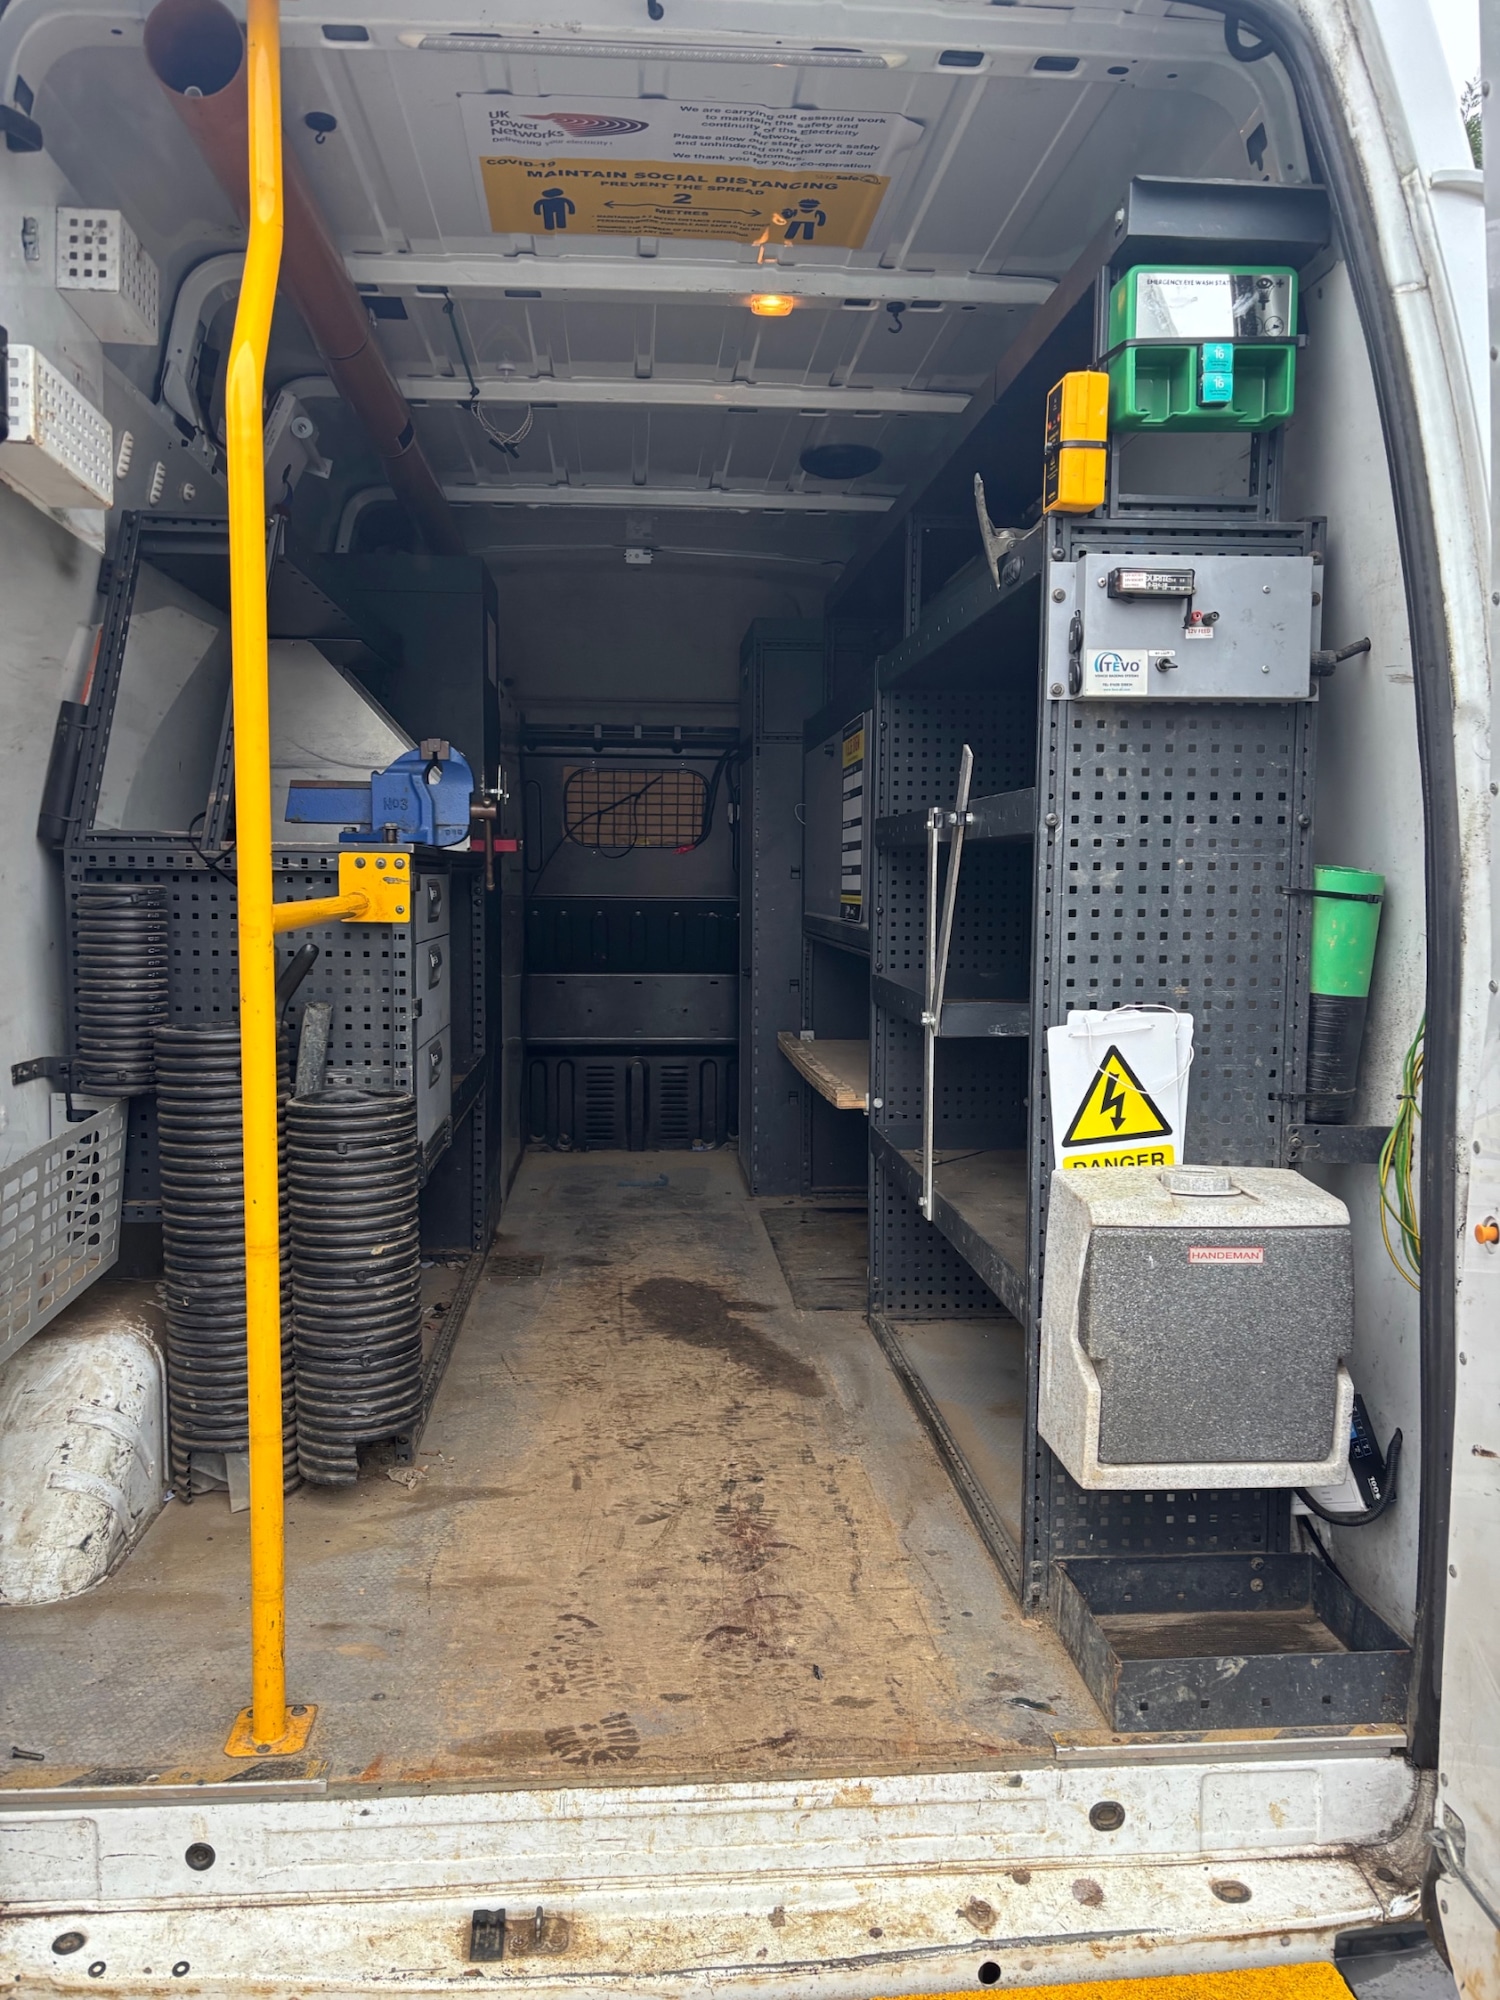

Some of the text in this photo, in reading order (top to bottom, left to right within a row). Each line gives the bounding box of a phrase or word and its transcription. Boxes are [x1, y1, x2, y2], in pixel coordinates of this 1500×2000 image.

[488, 110, 510, 119] UK
[724, 108, 775, 120] carrying
[490, 119, 539, 130] Power
[720, 115, 772, 126] maintain
[491, 127, 565, 139] Networks
[701, 121, 760, 130] continuity
[800, 129, 859, 137] Electricity
[492, 136, 608, 147] Delivering your electricity
[673, 132, 712, 140] Please
[771, 140, 798, 148] staff
[753, 131, 804, 142] Network.
[700, 141, 765, 152] unhindered
[742, 150, 805, 161] customers.
[486, 158, 556, 168] COVID-19
[753, 157, 769, 165] for
[800, 161, 872, 169] co-operation
[527, 169, 839, 190] MAINTAIN SOCIAL DISTANCING
[600, 180, 666, 189] PREVENT
[707, 185, 764, 196] SPREAD
[672, 193, 693, 204] 2
[655, 207, 709, 216] METRES
[1214, 348, 1225, 359] 16
[1213, 377, 1225, 389] 16
[1103, 661, 1140, 672] TEVO
